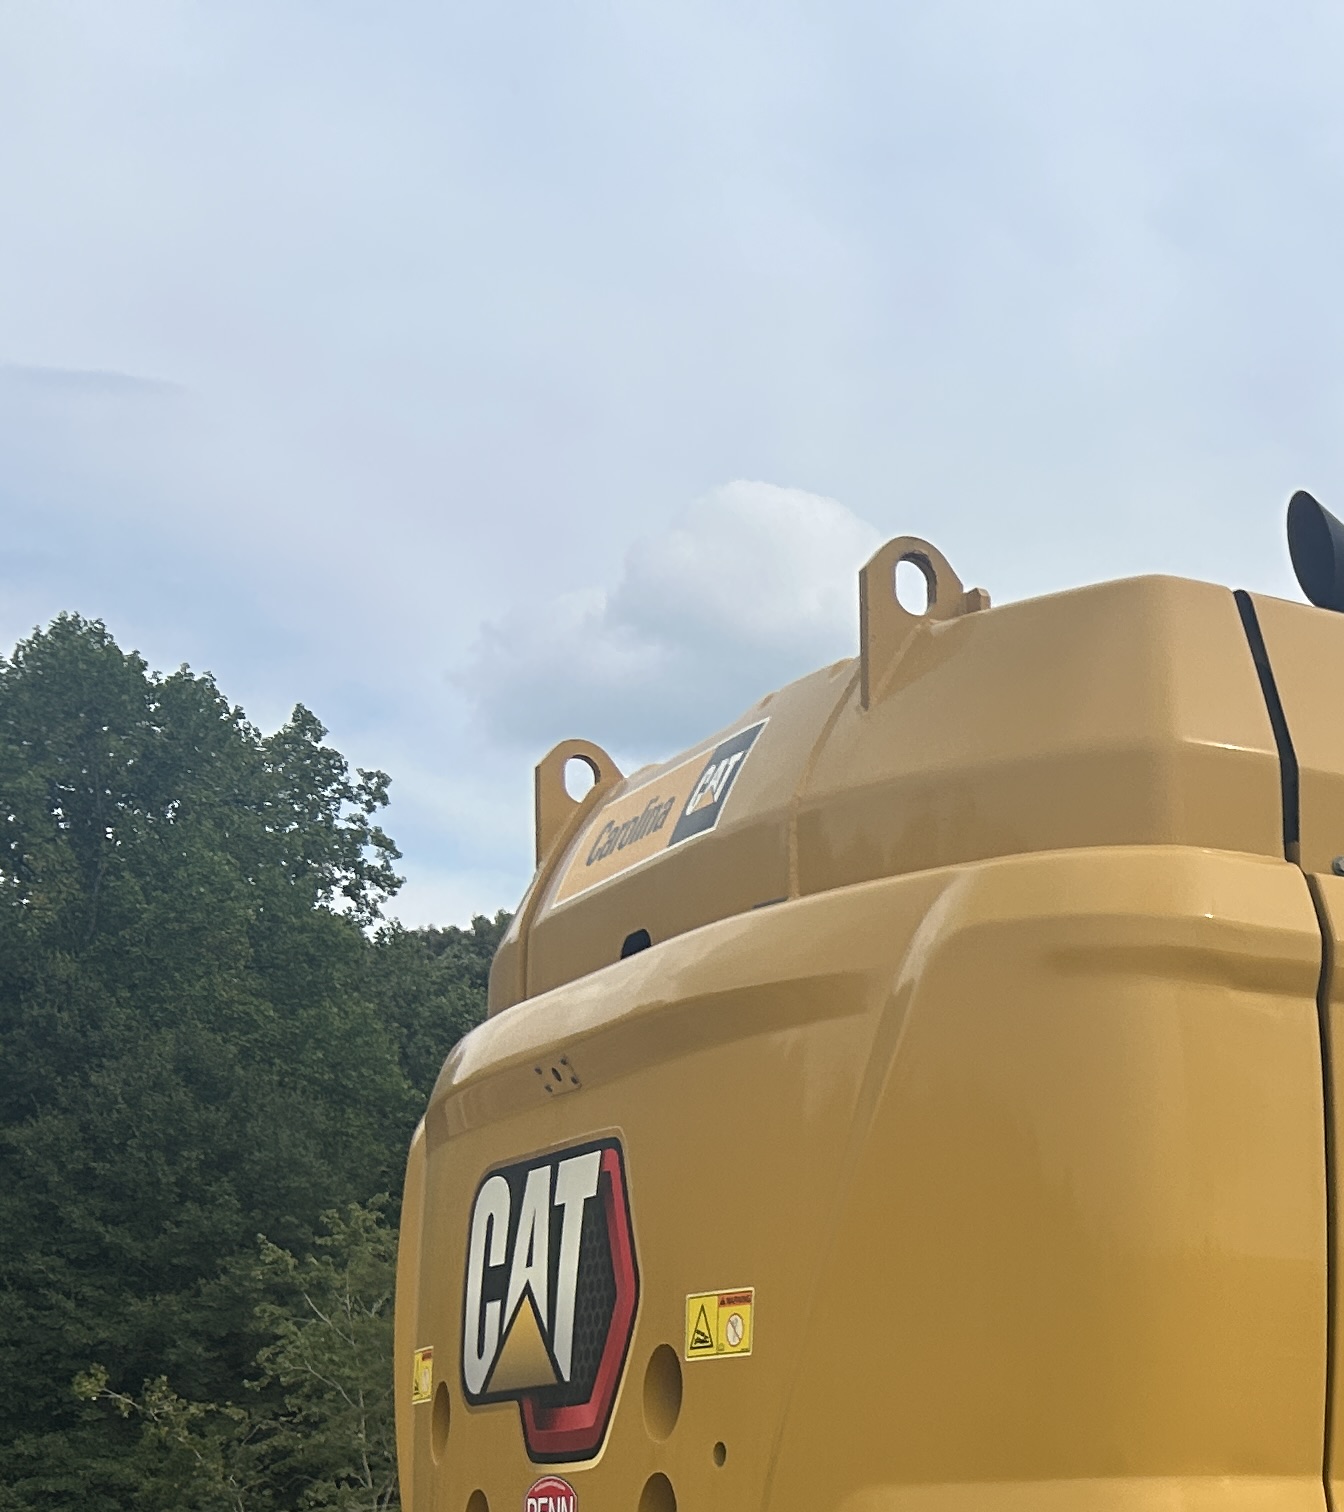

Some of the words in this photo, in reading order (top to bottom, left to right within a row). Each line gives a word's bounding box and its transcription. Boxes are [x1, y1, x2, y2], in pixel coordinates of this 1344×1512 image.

[586, 796, 676, 867] Carolina
[685, 751, 745, 816] CAT
[463, 1150, 602, 1395] CAT
